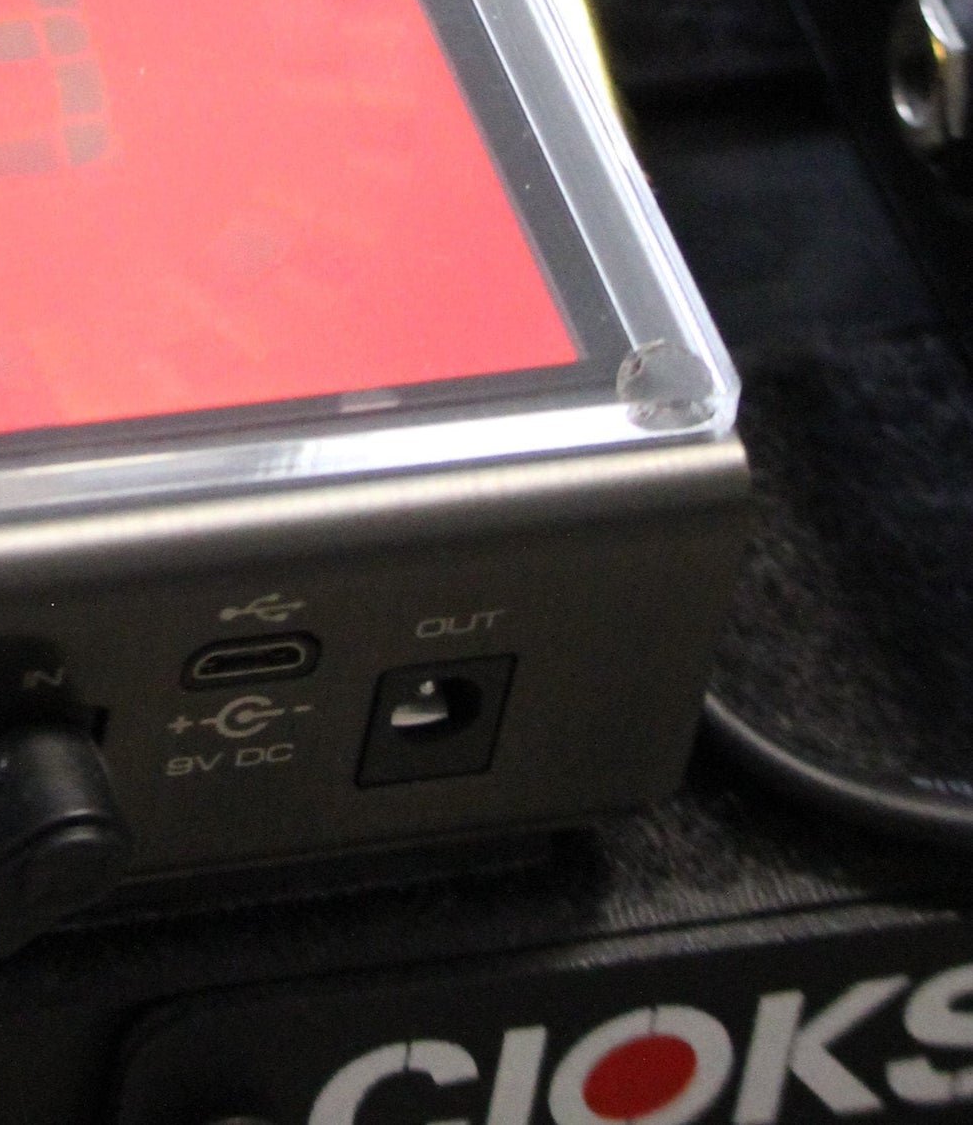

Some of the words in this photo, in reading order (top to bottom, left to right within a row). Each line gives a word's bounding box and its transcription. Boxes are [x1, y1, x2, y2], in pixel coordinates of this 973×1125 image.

[415, 609, 507, 640] OUT
[165, 751, 224, 777] 9V
[234, 742, 295, 767] DC
